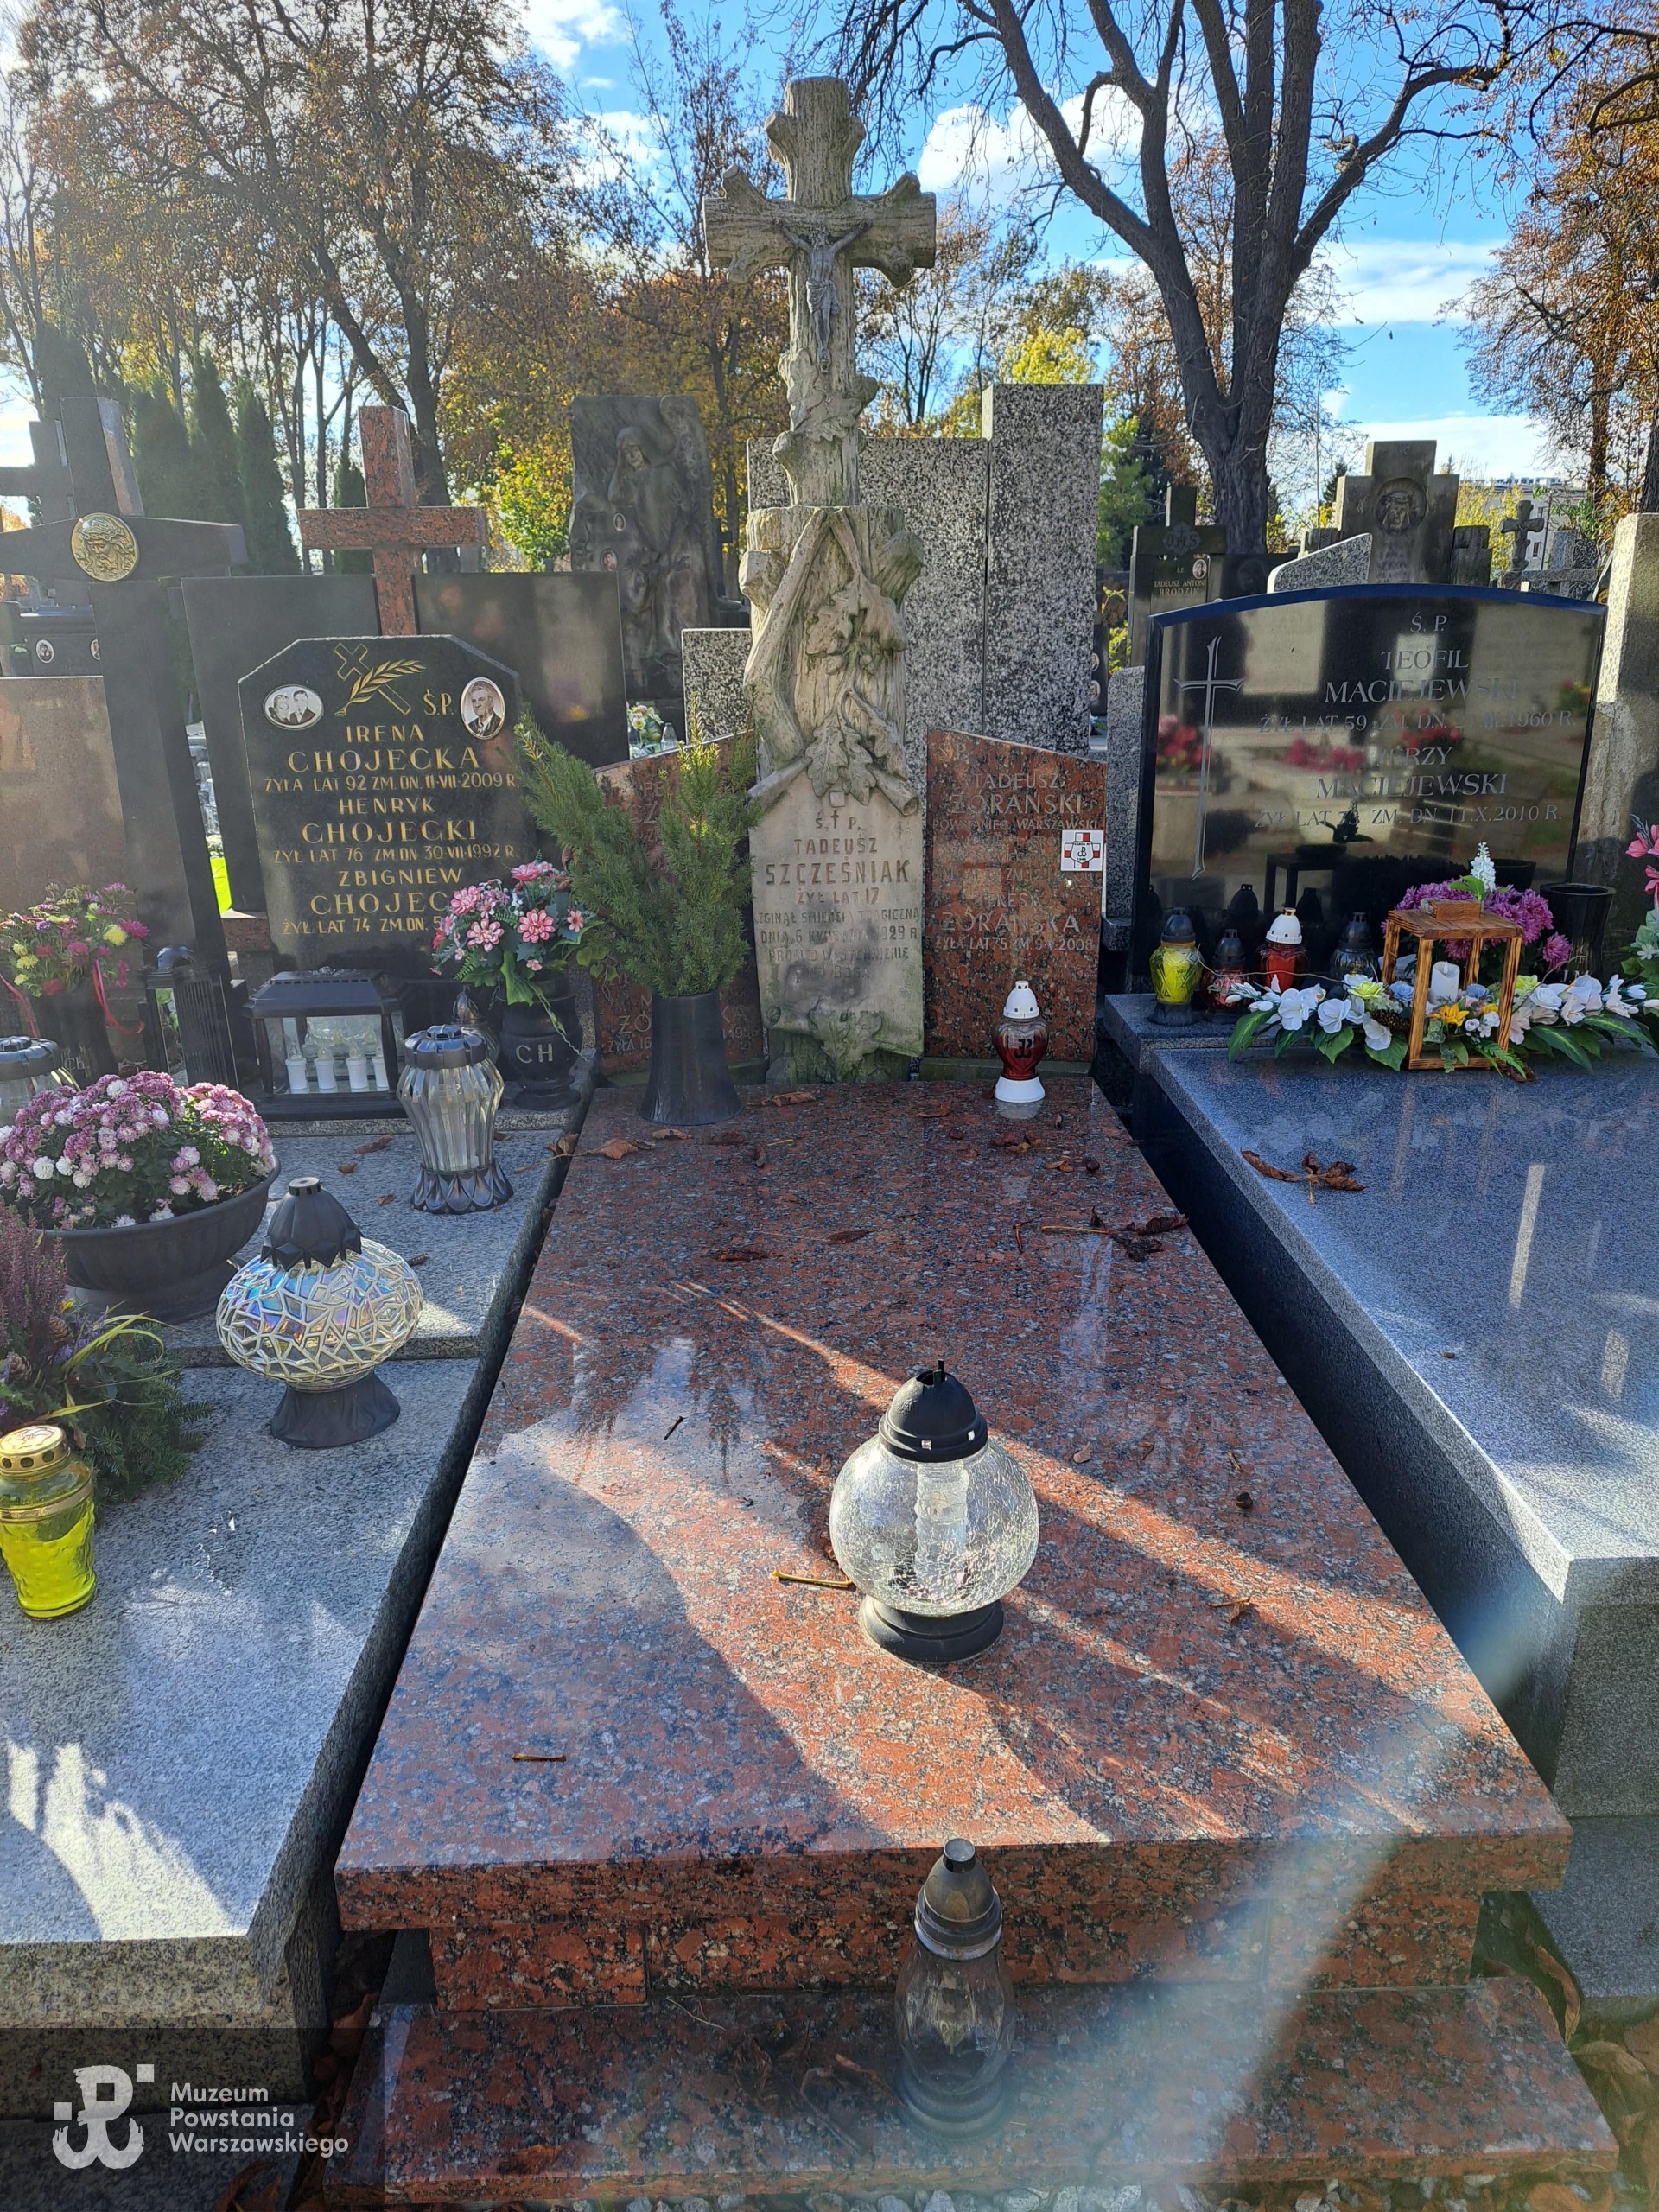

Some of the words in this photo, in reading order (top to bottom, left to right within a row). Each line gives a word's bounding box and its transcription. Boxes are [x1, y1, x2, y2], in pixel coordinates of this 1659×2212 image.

[1325, 677, 1517, 703] MACIEJEWSKI
[1260, 713, 1292, 733] ŻYŁ
[1301, 715, 1338, 732] LAT
[1344, 715, 1367, 731] 59
[1417, 713, 1447, 729] DN.
[1559, 710, 1576, 727] R.
[346, 724, 424, 743] IRENA
[288, 747, 480, 772] CHOJECKA
[313, 777, 340, 792] LAT
[346, 775, 367, 791] 92
[506, 773, 519, 788] R.
[974, 773, 1060, 789] TADEUSZ
[1316, 773, 1507, 799] MACIEJEWSKI
[339, 797, 435, 815] HENRYK
[1296, 810, 1332, 827] LAT
[1545, 804, 1562, 820] R.
[302, 820, 476, 844] CHOJECKI
[932, 820, 1008, 831] POWSTANIEC
[1016, 820, 1097, 830] WARSZAWSKI
[274, 848, 302, 863] ŻYŁ
[310, 849, 337, 863] LAT
[346, 847, 363, 862] 76
[505, 844, 518, 858] R.
[793, 837, 878, 855] TADEUSZ
[339, 868, 462, 887] ZBIGNIEW
[310, 891, 448, 915] CHOJEC
[833, 891, 859, 904] LAT
[865, 887, 880, 905] 17
[976, 893, 1043, 907] TERESA
[318, 919, 345, 934] LAT
[353, 918, 370, 933] 74
[760, 931, 789, 944] DNIA
[969, 938, 990, 950] LAT
[516, 1043, 553, 1064] CH
